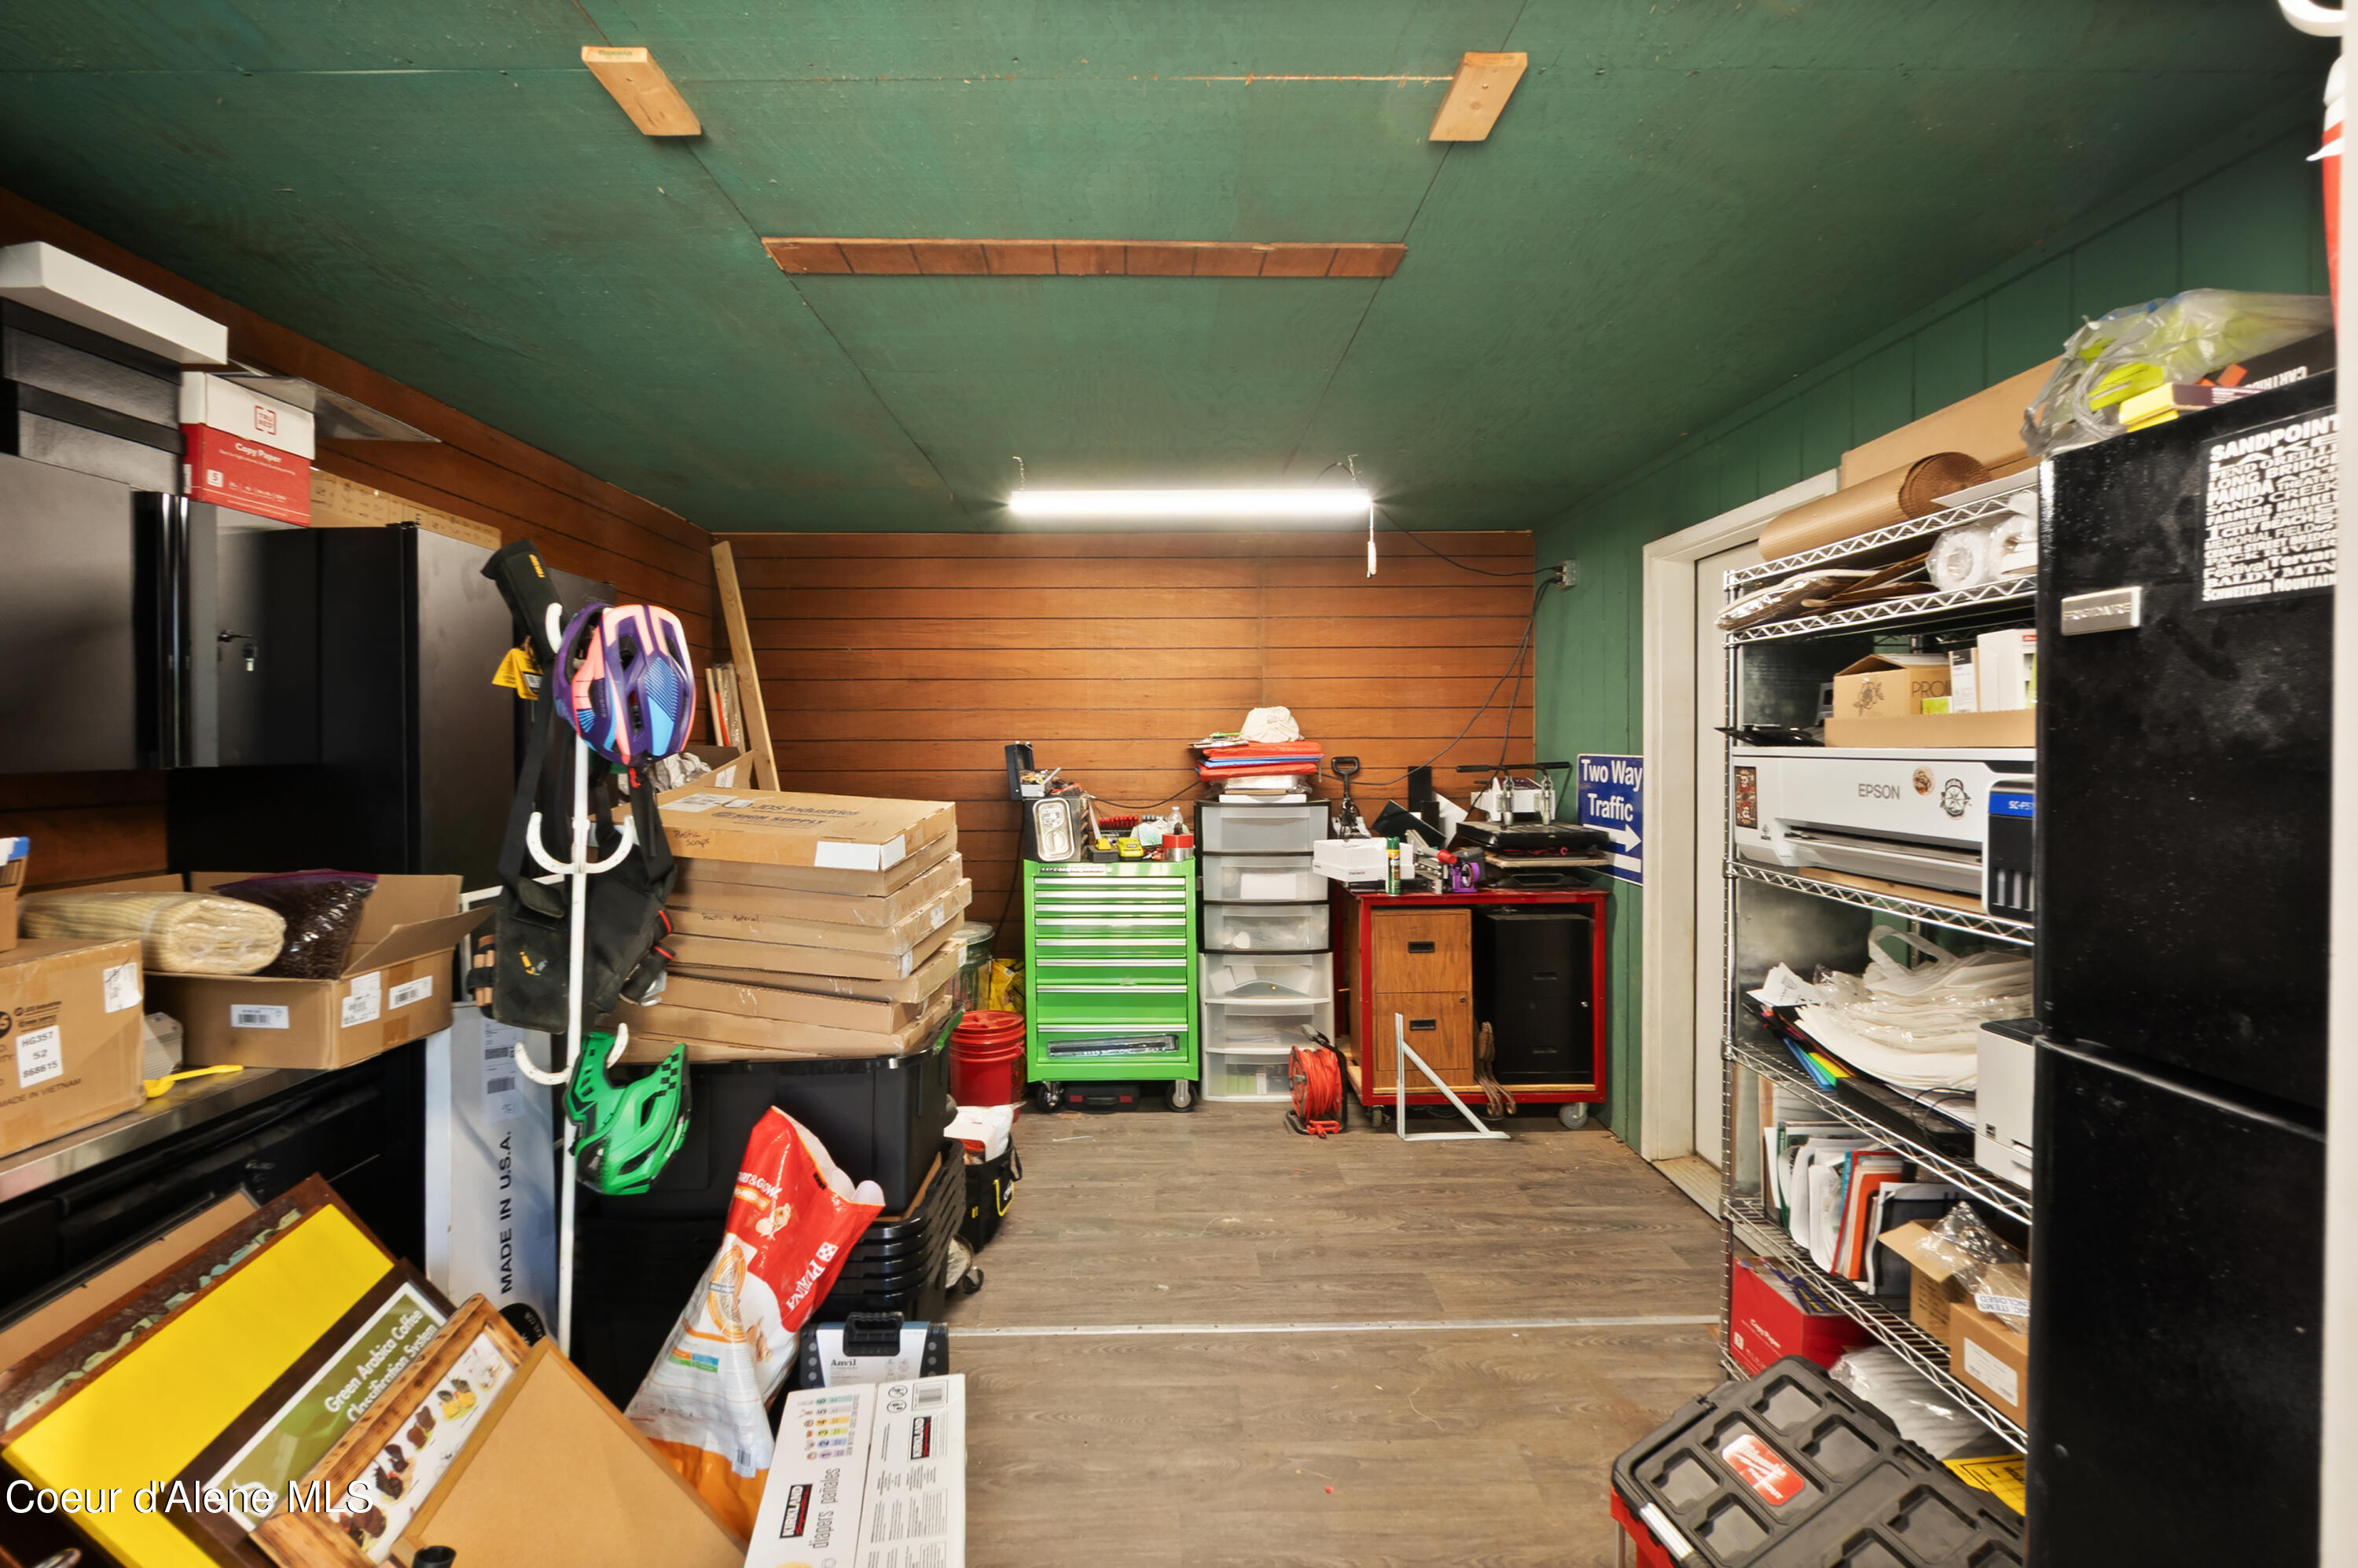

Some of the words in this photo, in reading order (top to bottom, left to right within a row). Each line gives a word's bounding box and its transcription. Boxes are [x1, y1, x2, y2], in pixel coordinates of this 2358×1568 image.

[2209, 413, 2339, 462] SANDPOINT
[235, 442, 256, 457] Copy
[257, 449, 282, 464] Paper
[2209, 431, 2339, 472] LAKE
[2208, 471, 2260, 492] LONG
[2209, 462, 2258, 482] PEND
[2206, 479, 2275, 506] PANIDA
[2206, 497, 2265, 516] SAND
[2268, 482, 2339, 503] CREEK
[2206, 504, 2273, 527] FARMERS
[2221, 523, 2259, 538] CITY
[2260, 513, 2314, 531] BEACH
[2204, 545, 2242, 560] CEDAR
[2243, 538, 2289, 553] STREET
[2205, 531, 2273, 550] MEMORIAL
[2275, 523, 2317, 539] FIELD
[2203, 559, 2269, 579] Festival
[2268, 549, 2338, 568] Tervan
[2205, 551, 2261, 567] PACK
[2203, 570, 2279, 589] BALDY
[2282, 561, 2338, 578] MTN
[1581, 759, 1609, 783] Two
[1611, 760, 1643, 792] Way
[1858, 784, 1901, 800] EPSON
[752, 803, 784, 812] JDS
[784, 805, 861, 817] Industries
[773, 816, 828, 825] SUPPLY
[1587, 793, 1633, 822] Traffic
[22, 1031, 53, 1048] HG357
[33, 1049, 47, 1060] 52
[23, 1060, 58, 1078] 868615
[41, 1078, 83, 1096] VIETNAM
[499, 1131, 512, 1191] U.S.A.
[500, 1196, 512, 1221] IN
[500, 1228, 512, 1295] MADE
[786, 1259, 826, 1312] PURINA
[1979, 1295, 2027, 1308] NCLOSED
[325, 1377, 362, 1412] Green
[356, 1338, 398, 1380] Arabica
[391, 1310, 424, 1340] Coffee
[830, 1358, 857, 1367] Anvil
[347, 1356, 410, 1421] Classification
[817, 1467, 841, 1505] pañales
[781, 1485, 805, 1537] KIRKLAND
[809, 1511, 835, 1549] diapers
